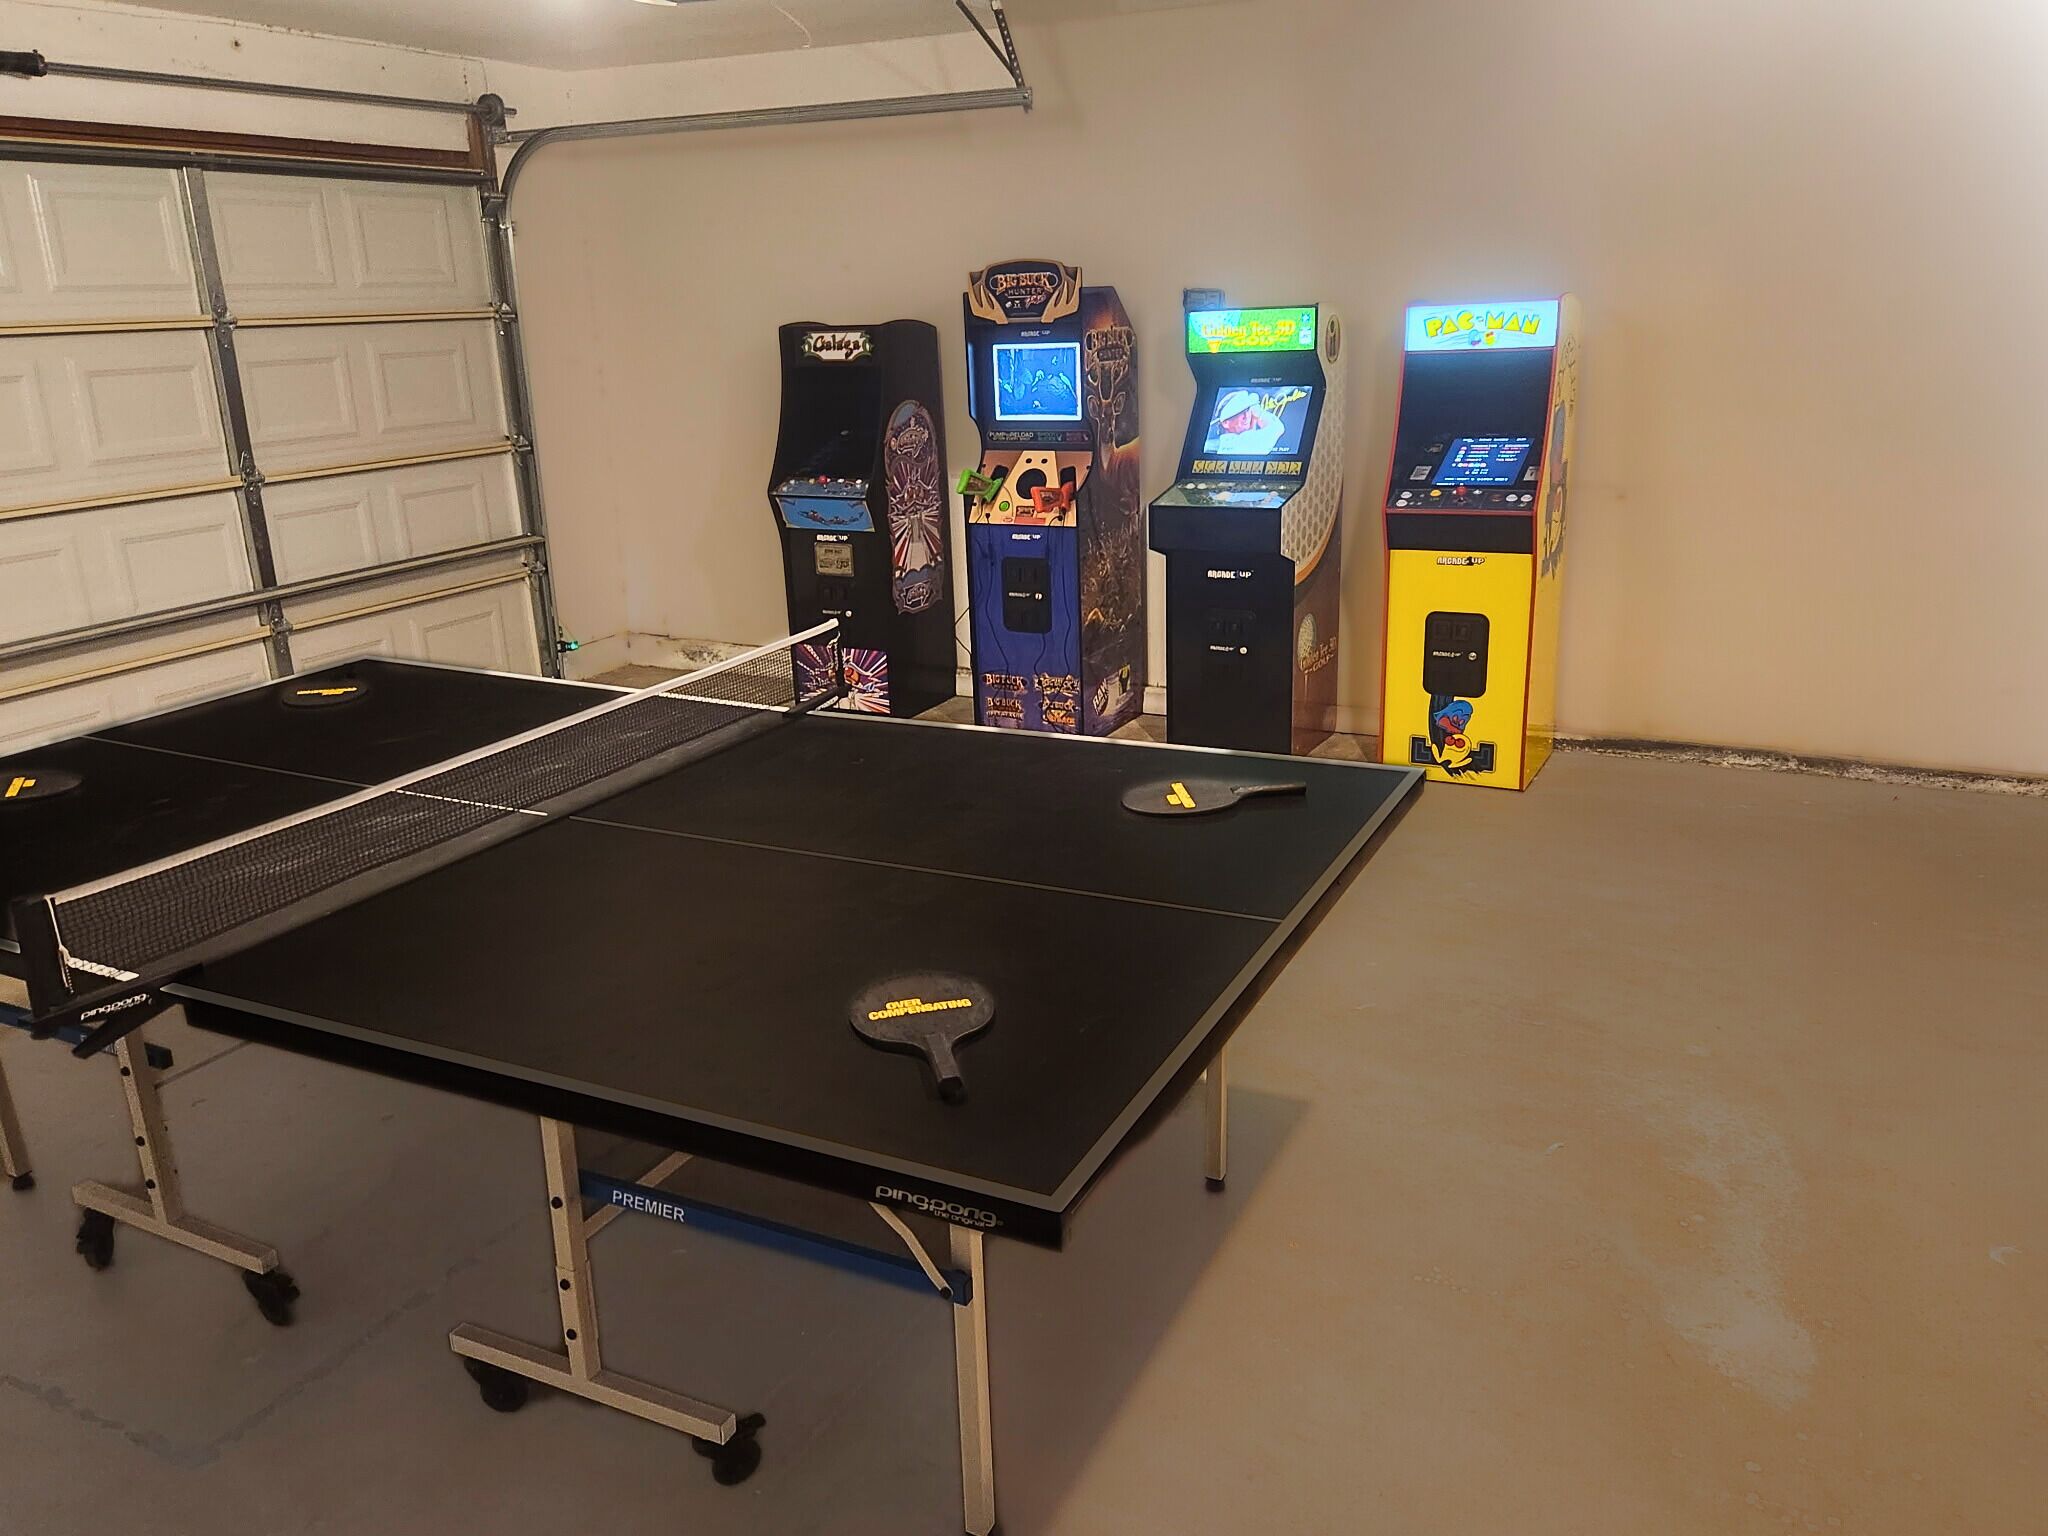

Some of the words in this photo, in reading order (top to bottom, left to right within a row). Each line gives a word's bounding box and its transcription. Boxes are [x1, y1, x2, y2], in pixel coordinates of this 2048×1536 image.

[997, 274, 1017, 290] BIG
[1019, 272, 1053, 291] BUCK
[1008, 288, 1042, 296] HUNTER
[1424, 310, 1541, 338] PAC-MAN
[868, 998, 972, 1021] COMPENSATING
[885, 998, 922, 1010] OVER
[612, 1190, 685, 1222] PREMIER
[875, 1185, 997, 1227] pingpong
[934, 1210, 950, 1219] the
[951, 1214, 985, 1227] original
